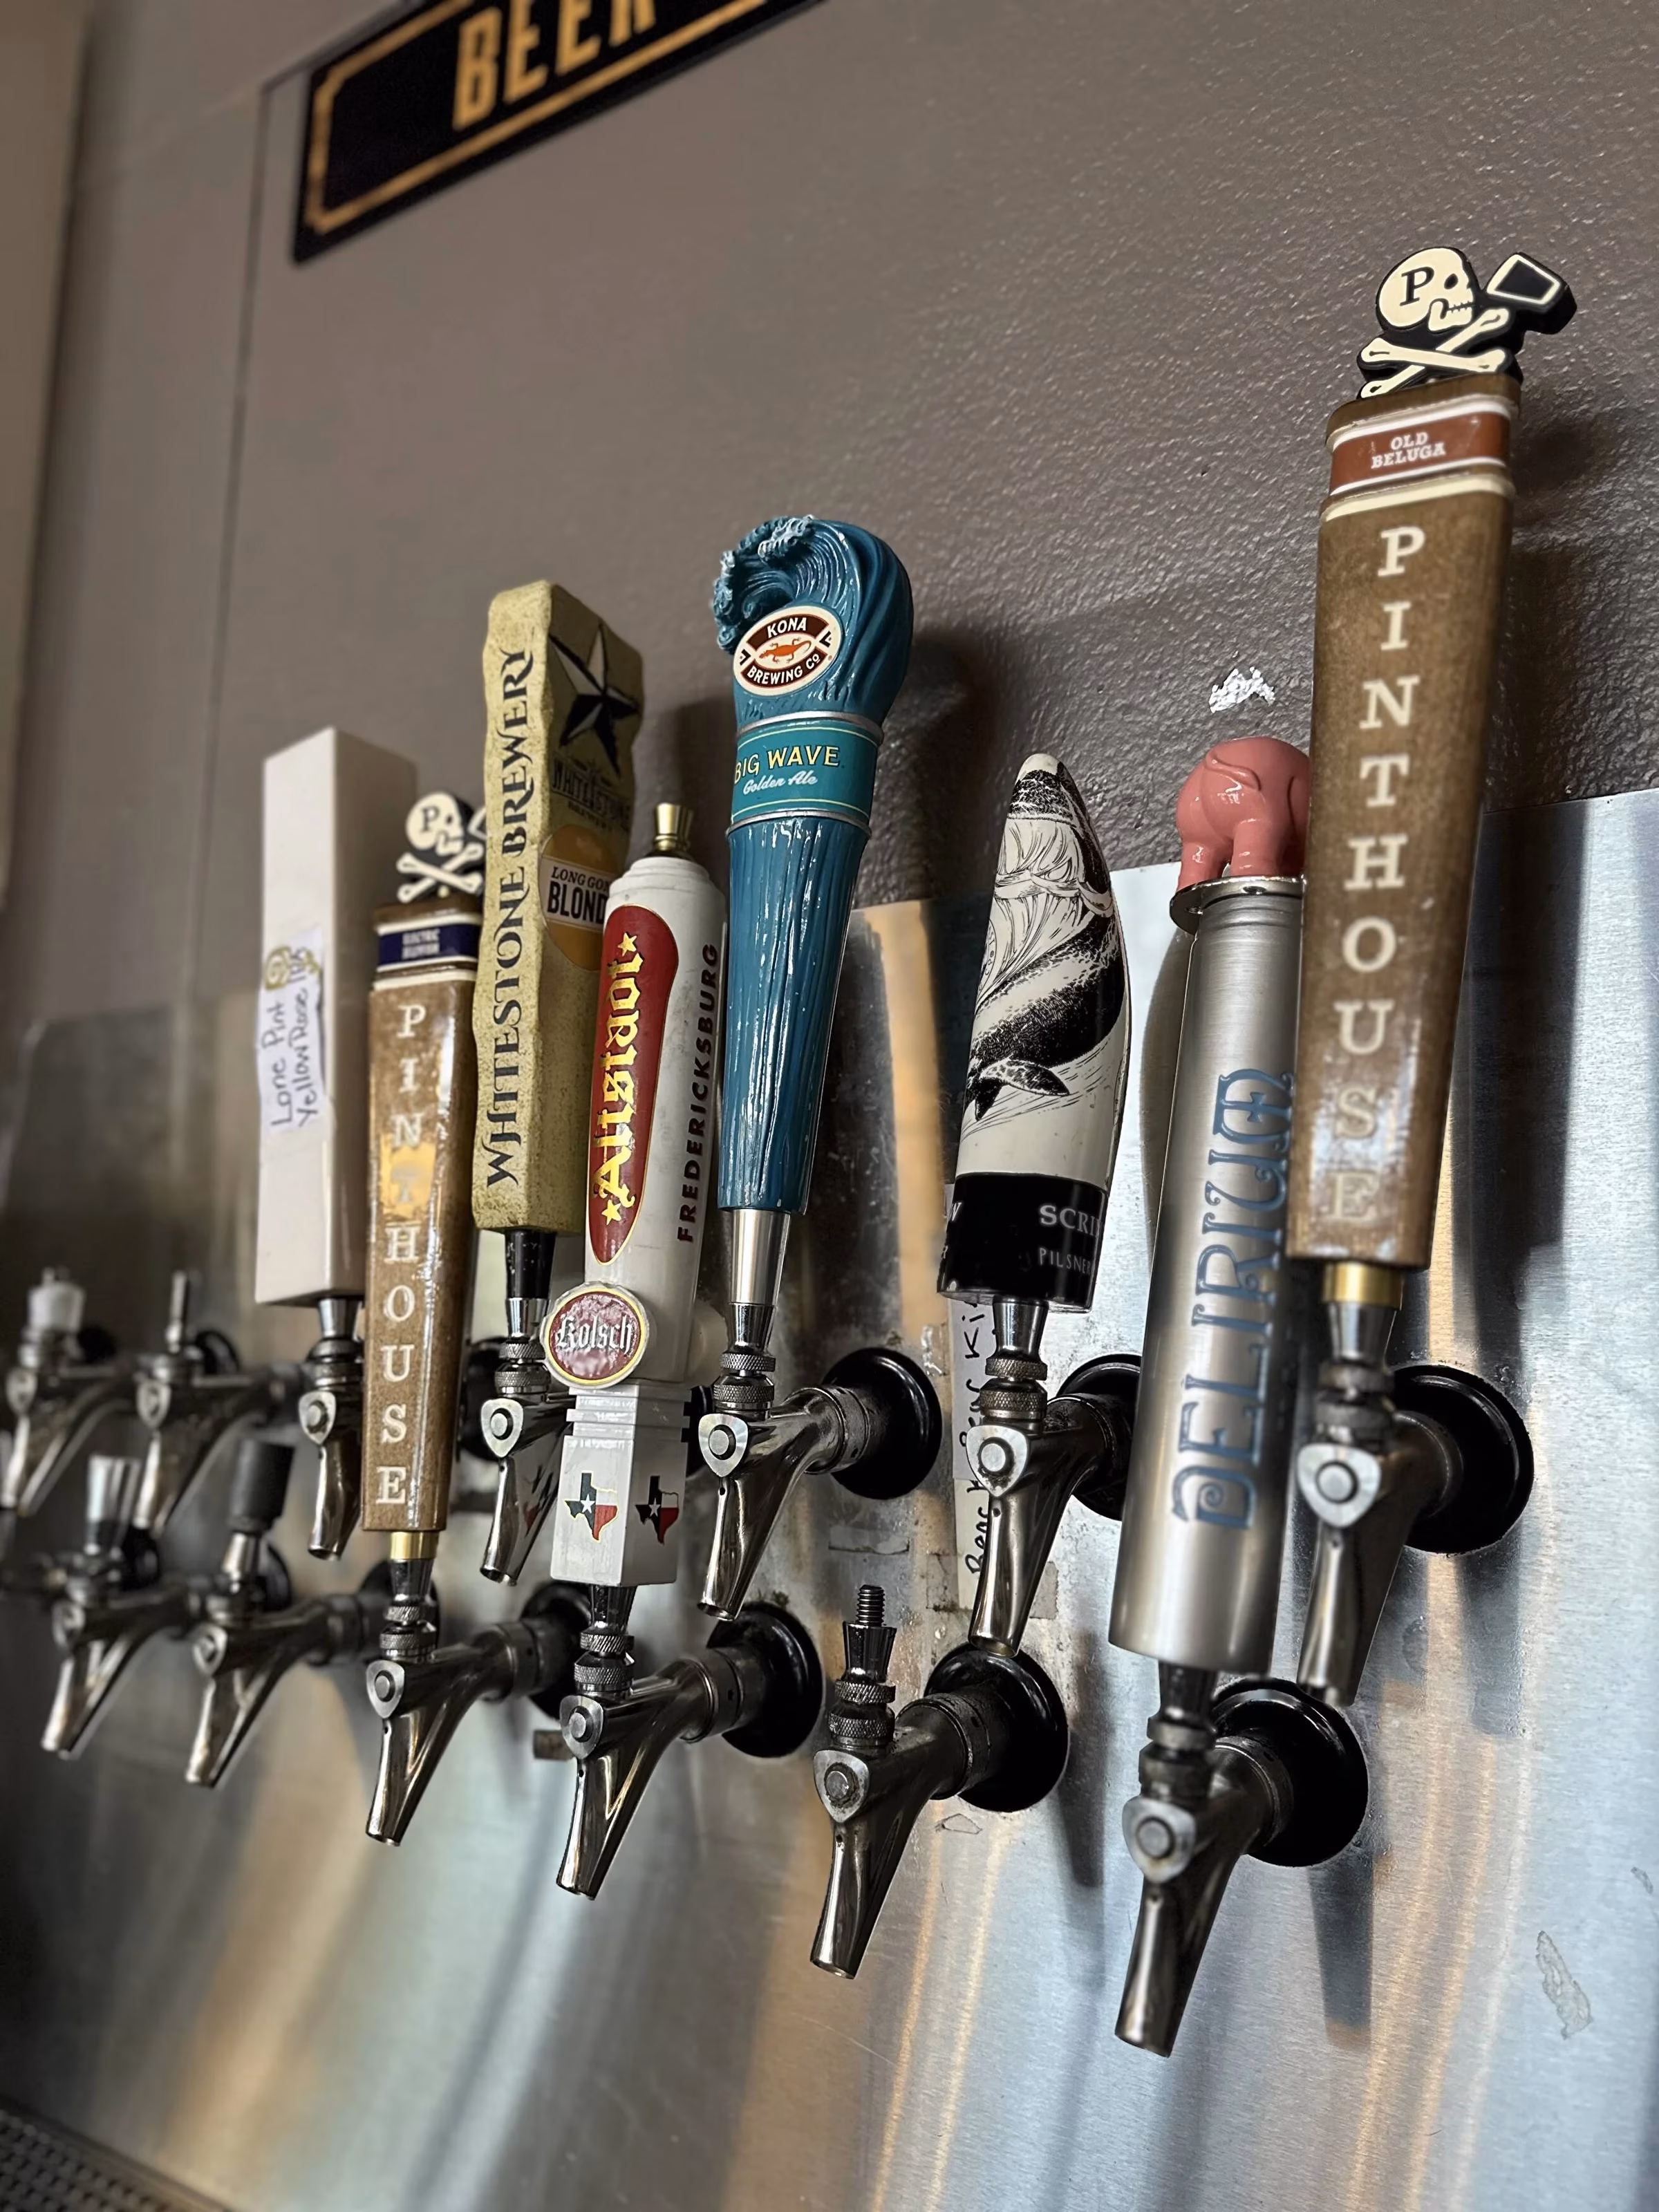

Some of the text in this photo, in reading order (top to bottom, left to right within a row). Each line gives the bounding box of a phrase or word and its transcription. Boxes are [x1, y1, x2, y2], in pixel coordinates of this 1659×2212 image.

[1399, 266, 1435, 306] P
[1371, 442, 1445, 469] BELUGA
[1390, 431, 1429, 451] OLD
[767, 617, 807, 639] KONA
[747, 665, 803, 685] BREWING
[734, 744, 841, 785] BIG WAVE
[743, 769, 818, 795] Golden Ale
[551, 866, 610, 892] LONG GON
[1325, 526, 1426, 1224] PINTHOUSE
[485, 648, 534, 1188] WHITESTONE BREWERY
[547, 880, 609, 925] BLOND
[288, 988, 308, 1048] Rose
[261, 1000, 292, 1127] Lone Pint
[590, 952, 644, 1208] Altstadt
[292, 1047, 318, 1127] Yellow
[677, 944, 718, 1243] FREDERICKSBURG
[1039, 1204, 1100, 1237] SCRI
[1038, 1247, 1091, 1275] PILSNER
[1172, 1068, 1293, 1530] DELIRIUM
[554, 1313, 632, 1355] Kolsch
